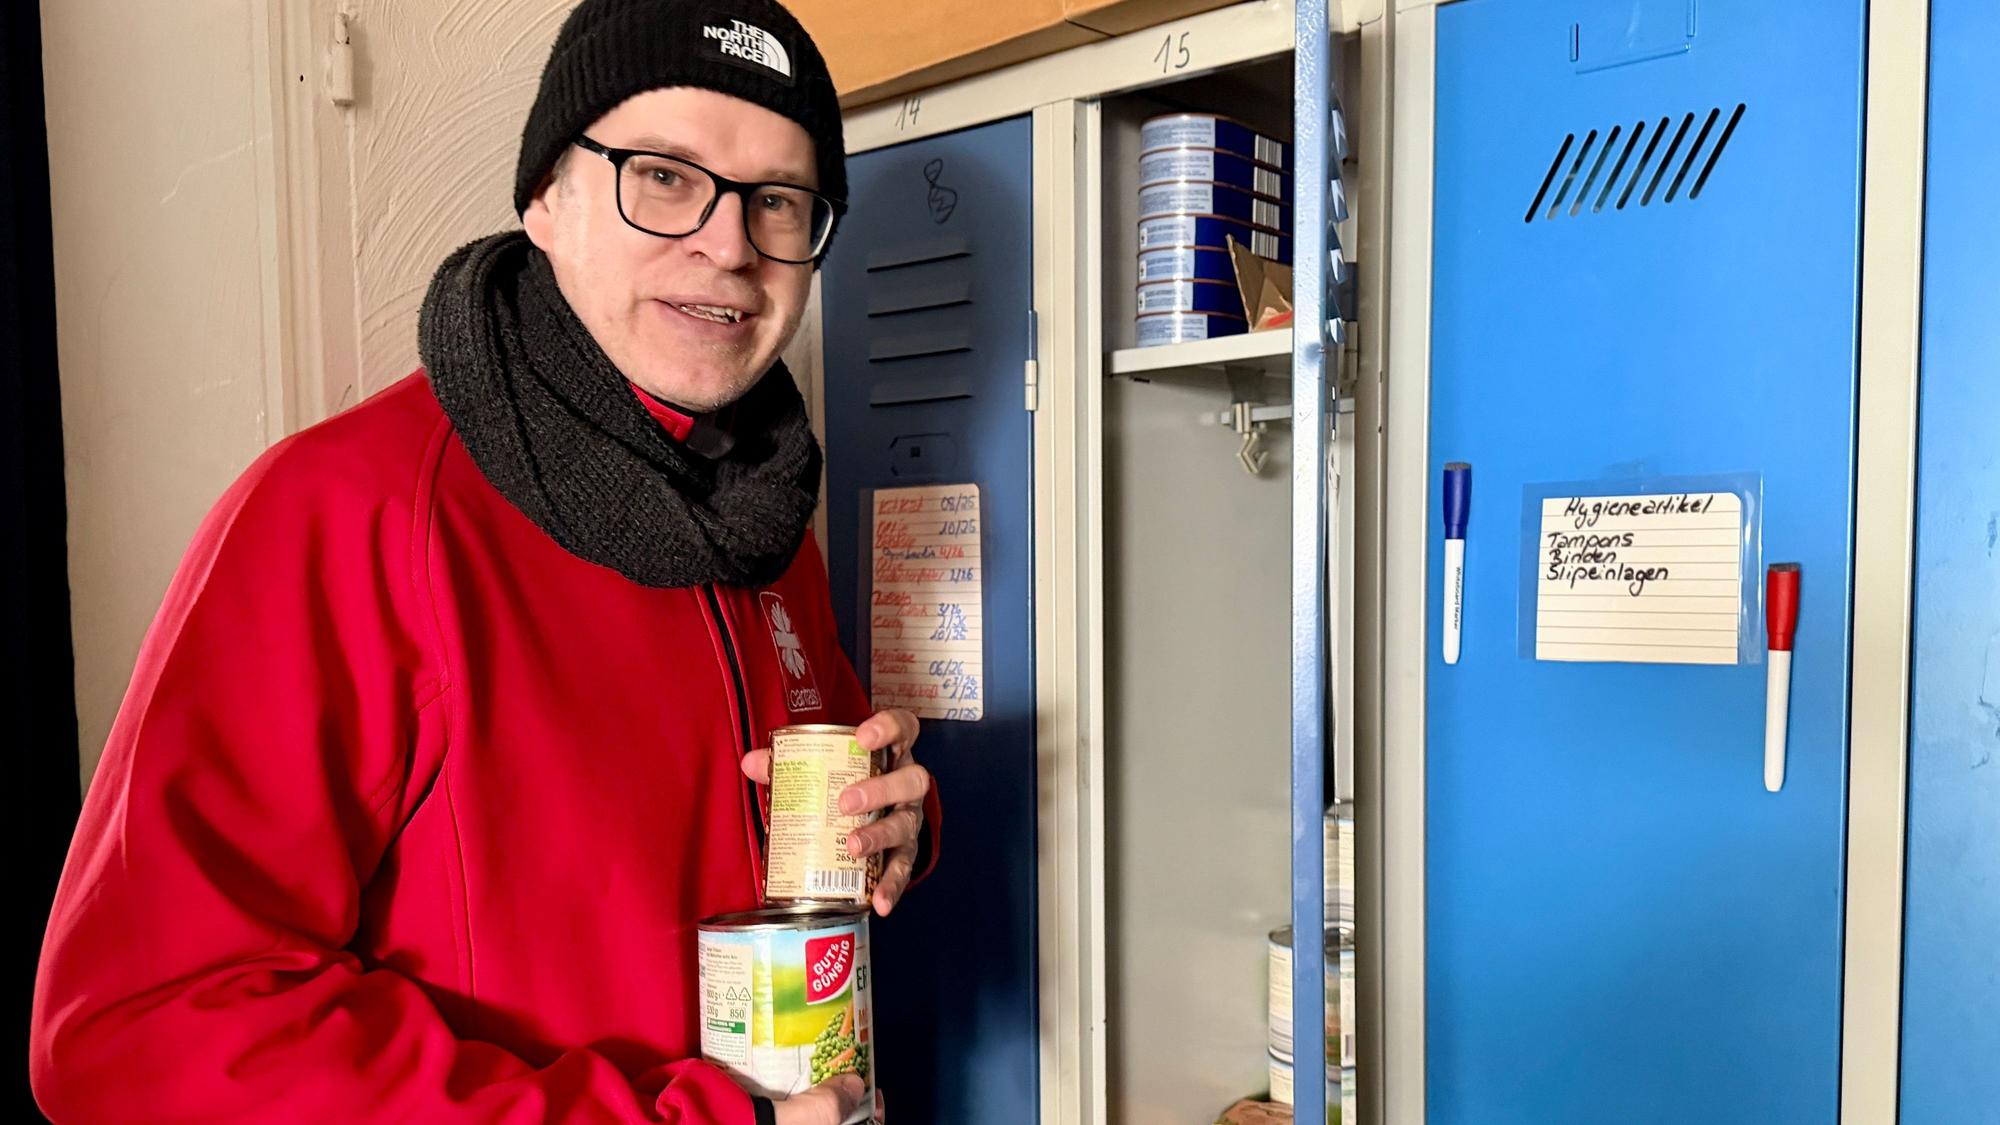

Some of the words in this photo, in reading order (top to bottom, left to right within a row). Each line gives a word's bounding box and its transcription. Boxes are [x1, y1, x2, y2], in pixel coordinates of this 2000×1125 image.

[703, 25, 764, 51] NORTH
[730, 19, 764, 40] THE
[720, 41, 764, 64] FACE
[1153, 32, 1190, 73] 15
[1563, 494, 1714, 530] Hygieneartikel
[1547, 532, 1635, 551] Tampons
[1548, 548, 1617, 565] Binden
[1546, 562, 1669, 597] Slipeinlagen
[812, 939, 850, 993] GÜNSTIG
[729, 1008, 745, 1019] 850
